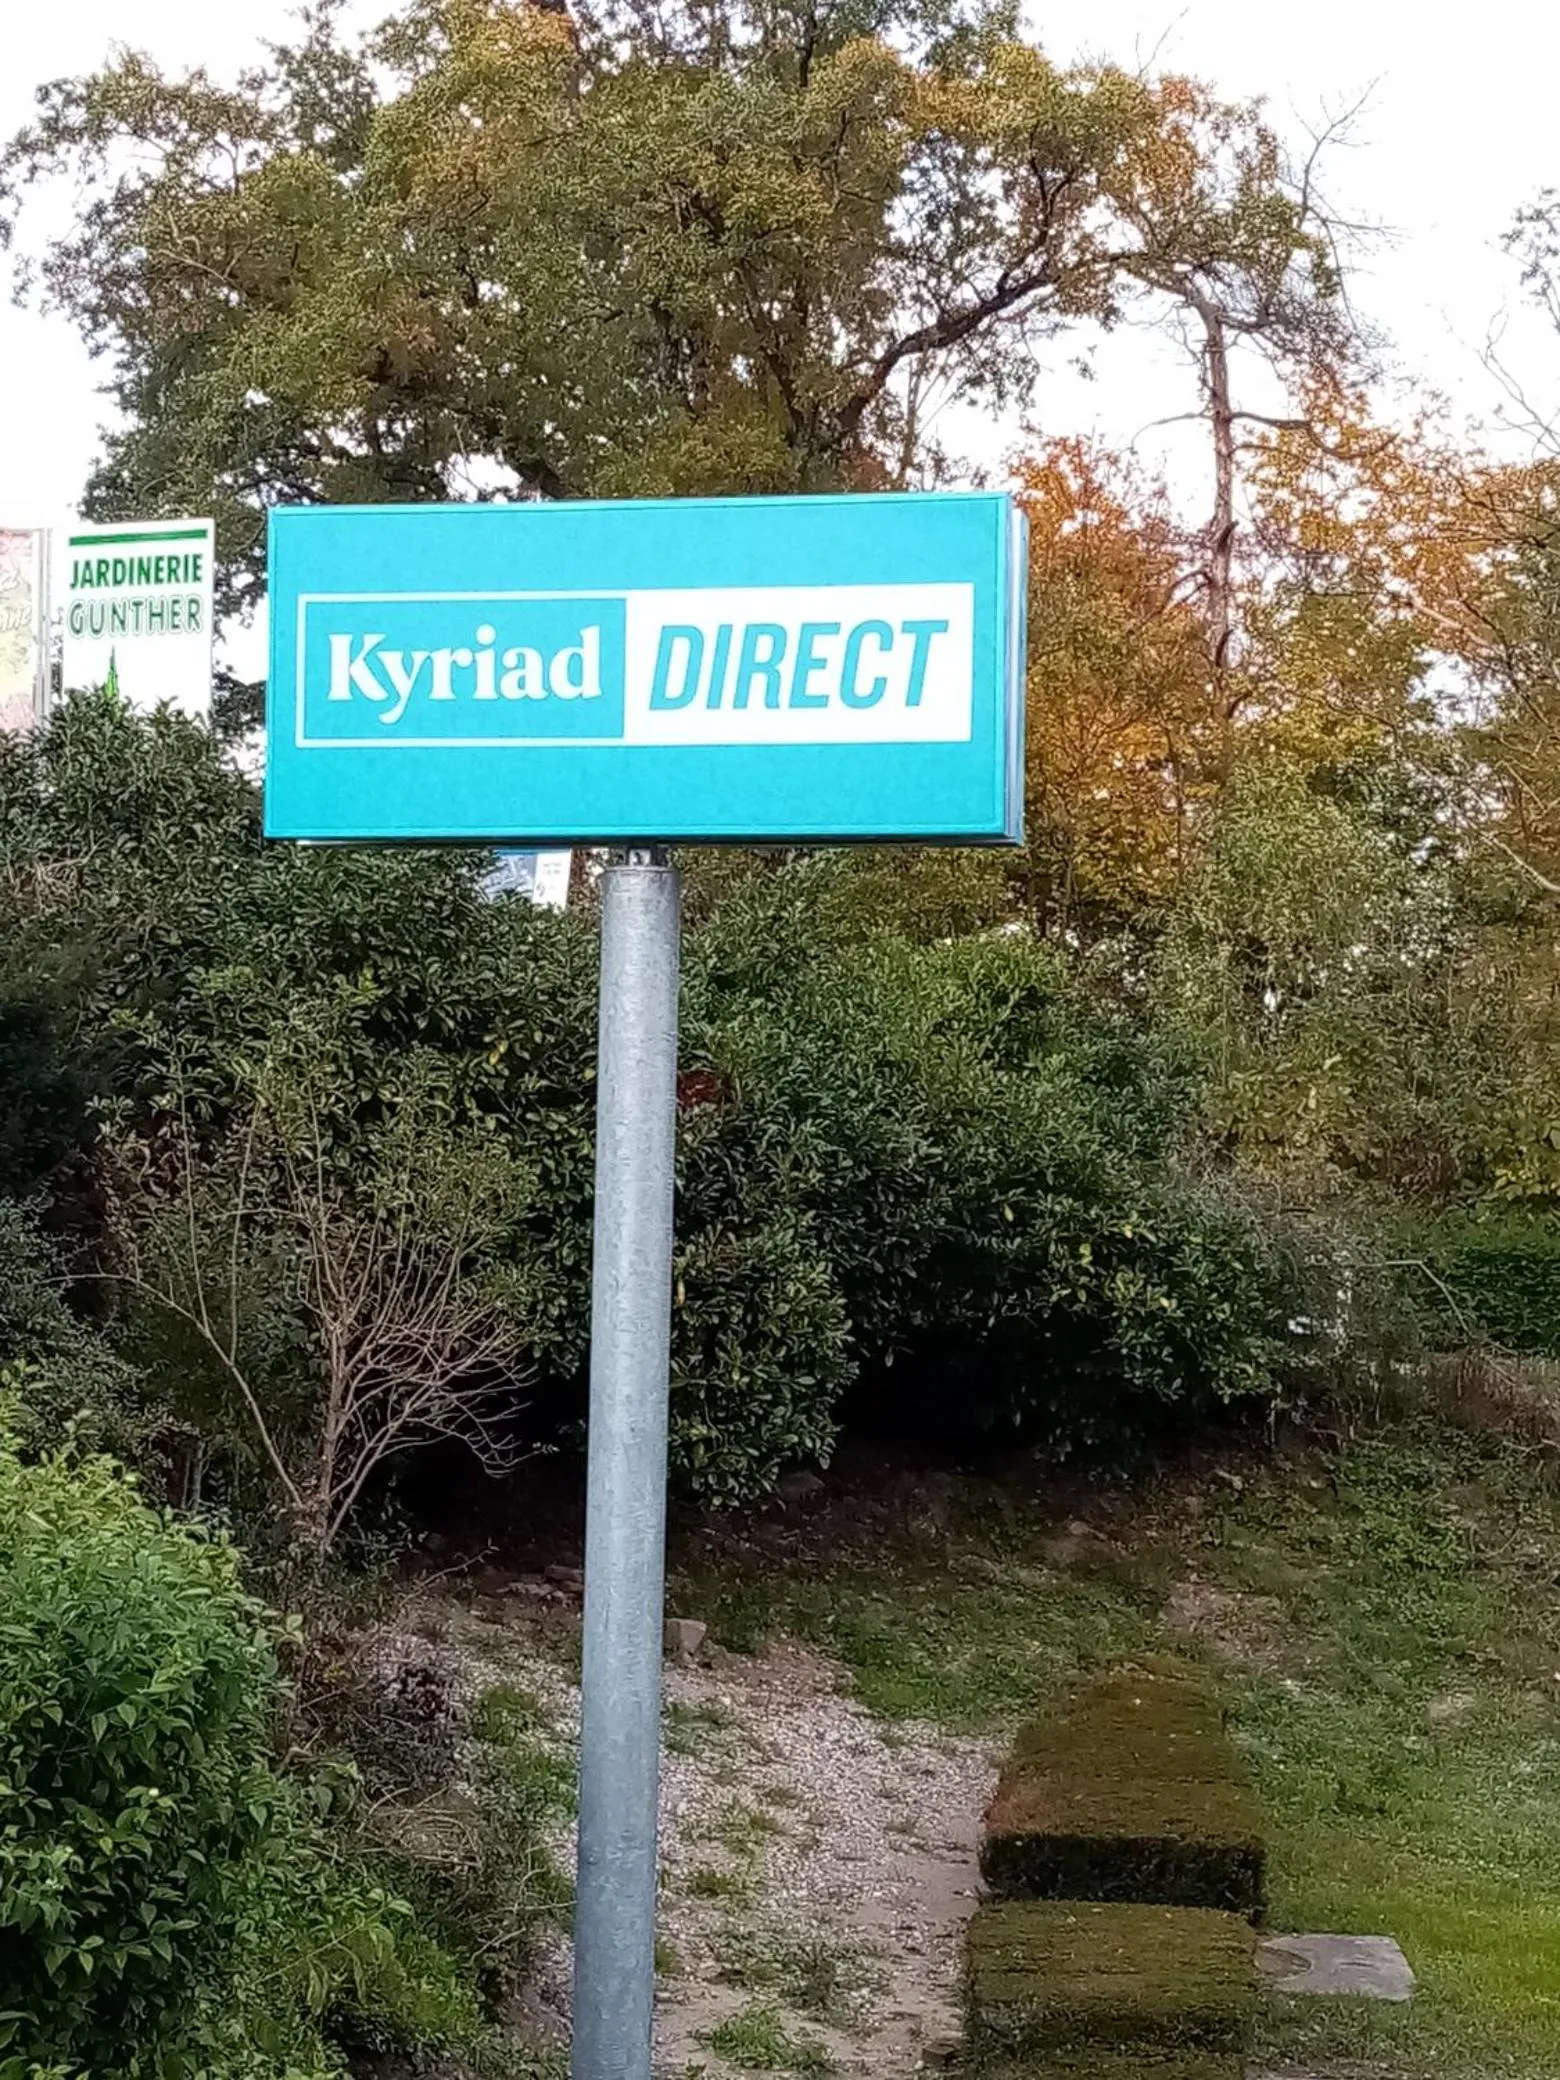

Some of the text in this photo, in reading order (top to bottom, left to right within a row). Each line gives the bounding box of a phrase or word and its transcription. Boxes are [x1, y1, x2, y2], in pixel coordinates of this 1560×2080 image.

[69, 553, 204, 590] JARDINERIE
[68, 595, 203, 638] GUNTHER
[326, 619, 950, 725] Kyriad DIRECT
